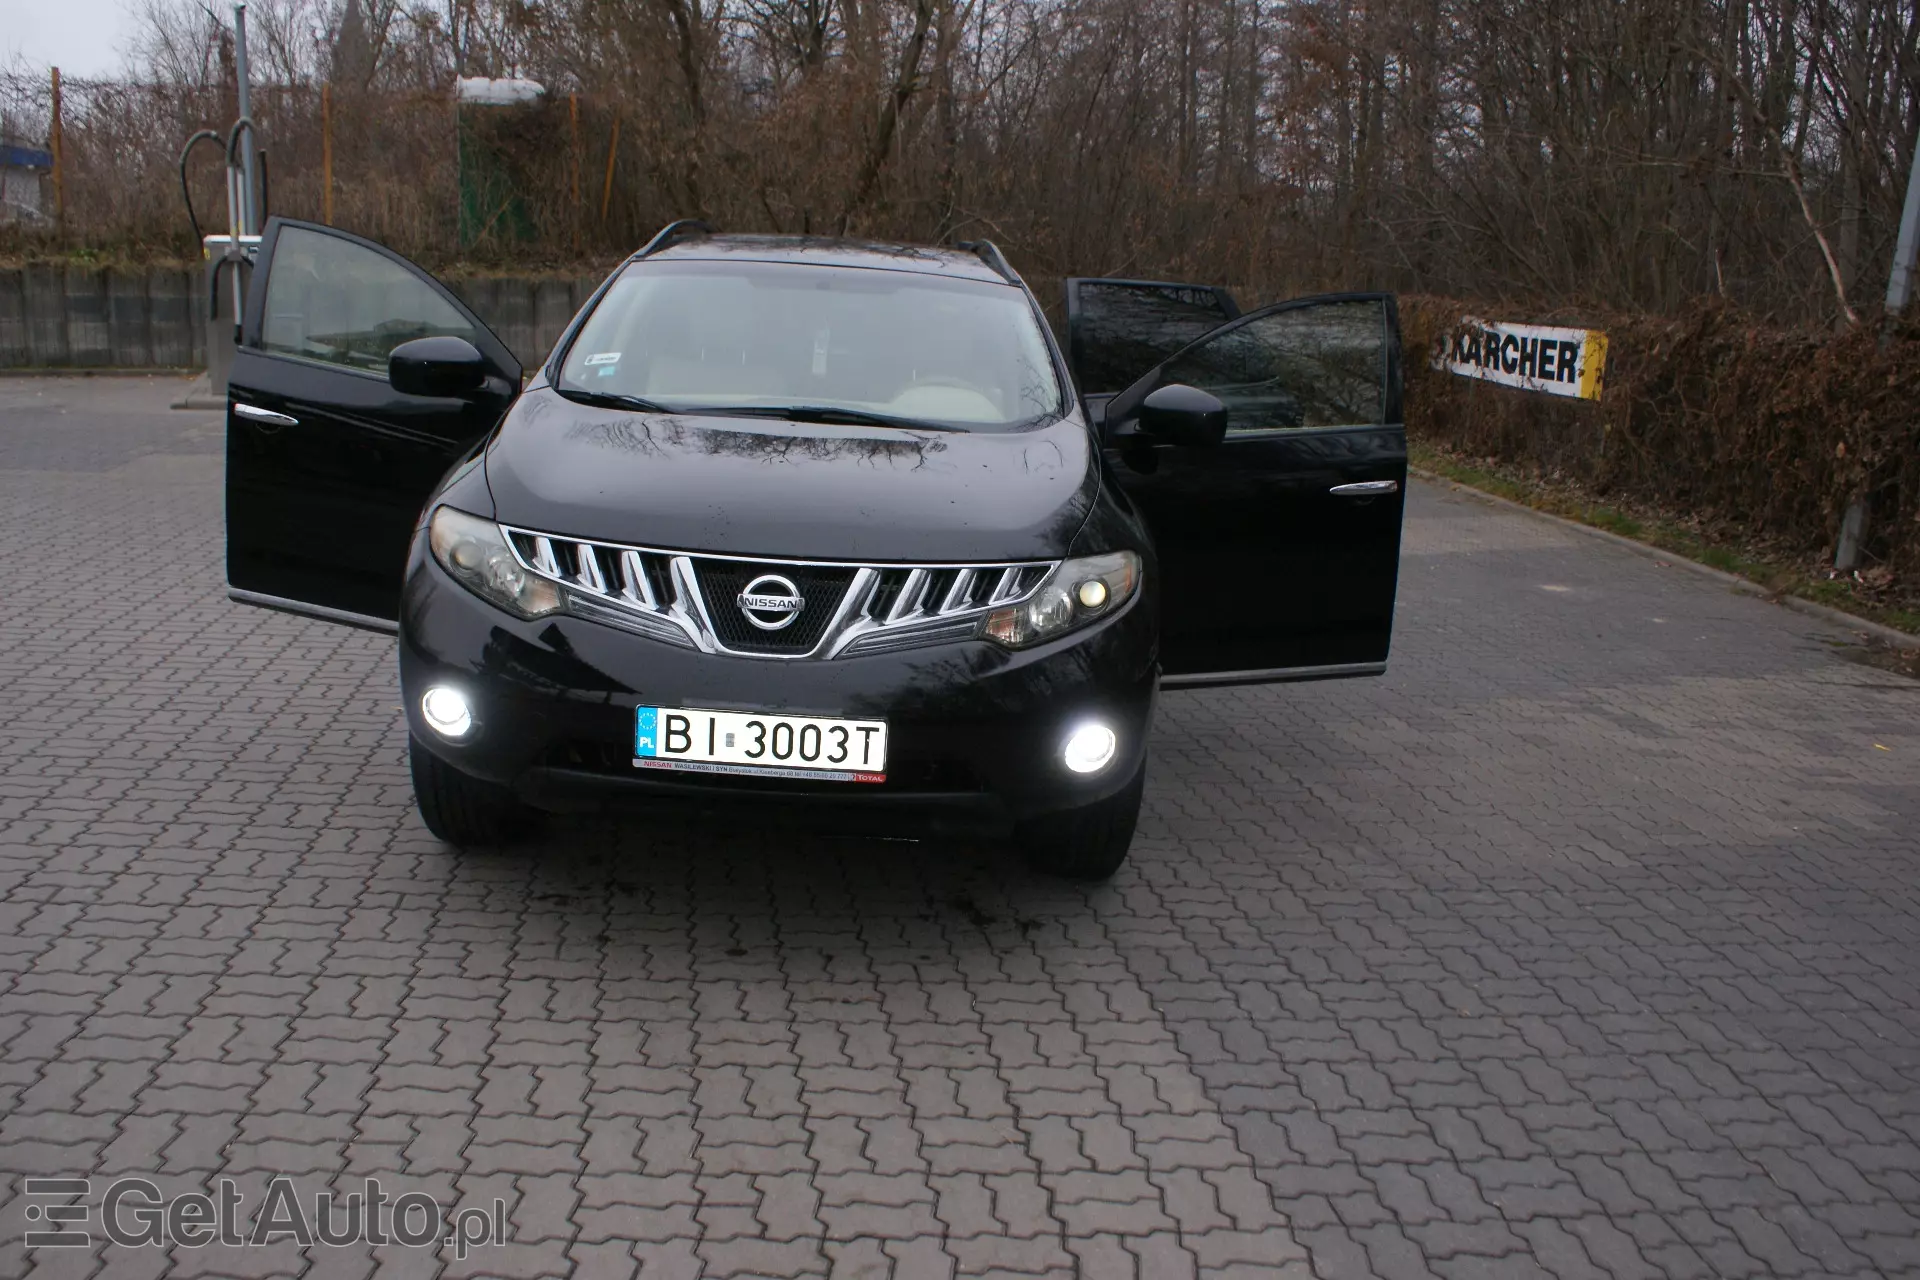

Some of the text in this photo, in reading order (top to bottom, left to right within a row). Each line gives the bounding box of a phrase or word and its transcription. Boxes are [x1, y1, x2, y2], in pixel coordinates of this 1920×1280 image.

[744, 597, 797, 609] NISSAN
[639, 736, 655, 749] PL
[664, 714, 880, 765] BI 3003T
[643, 761, 672, 769] NISSAN
